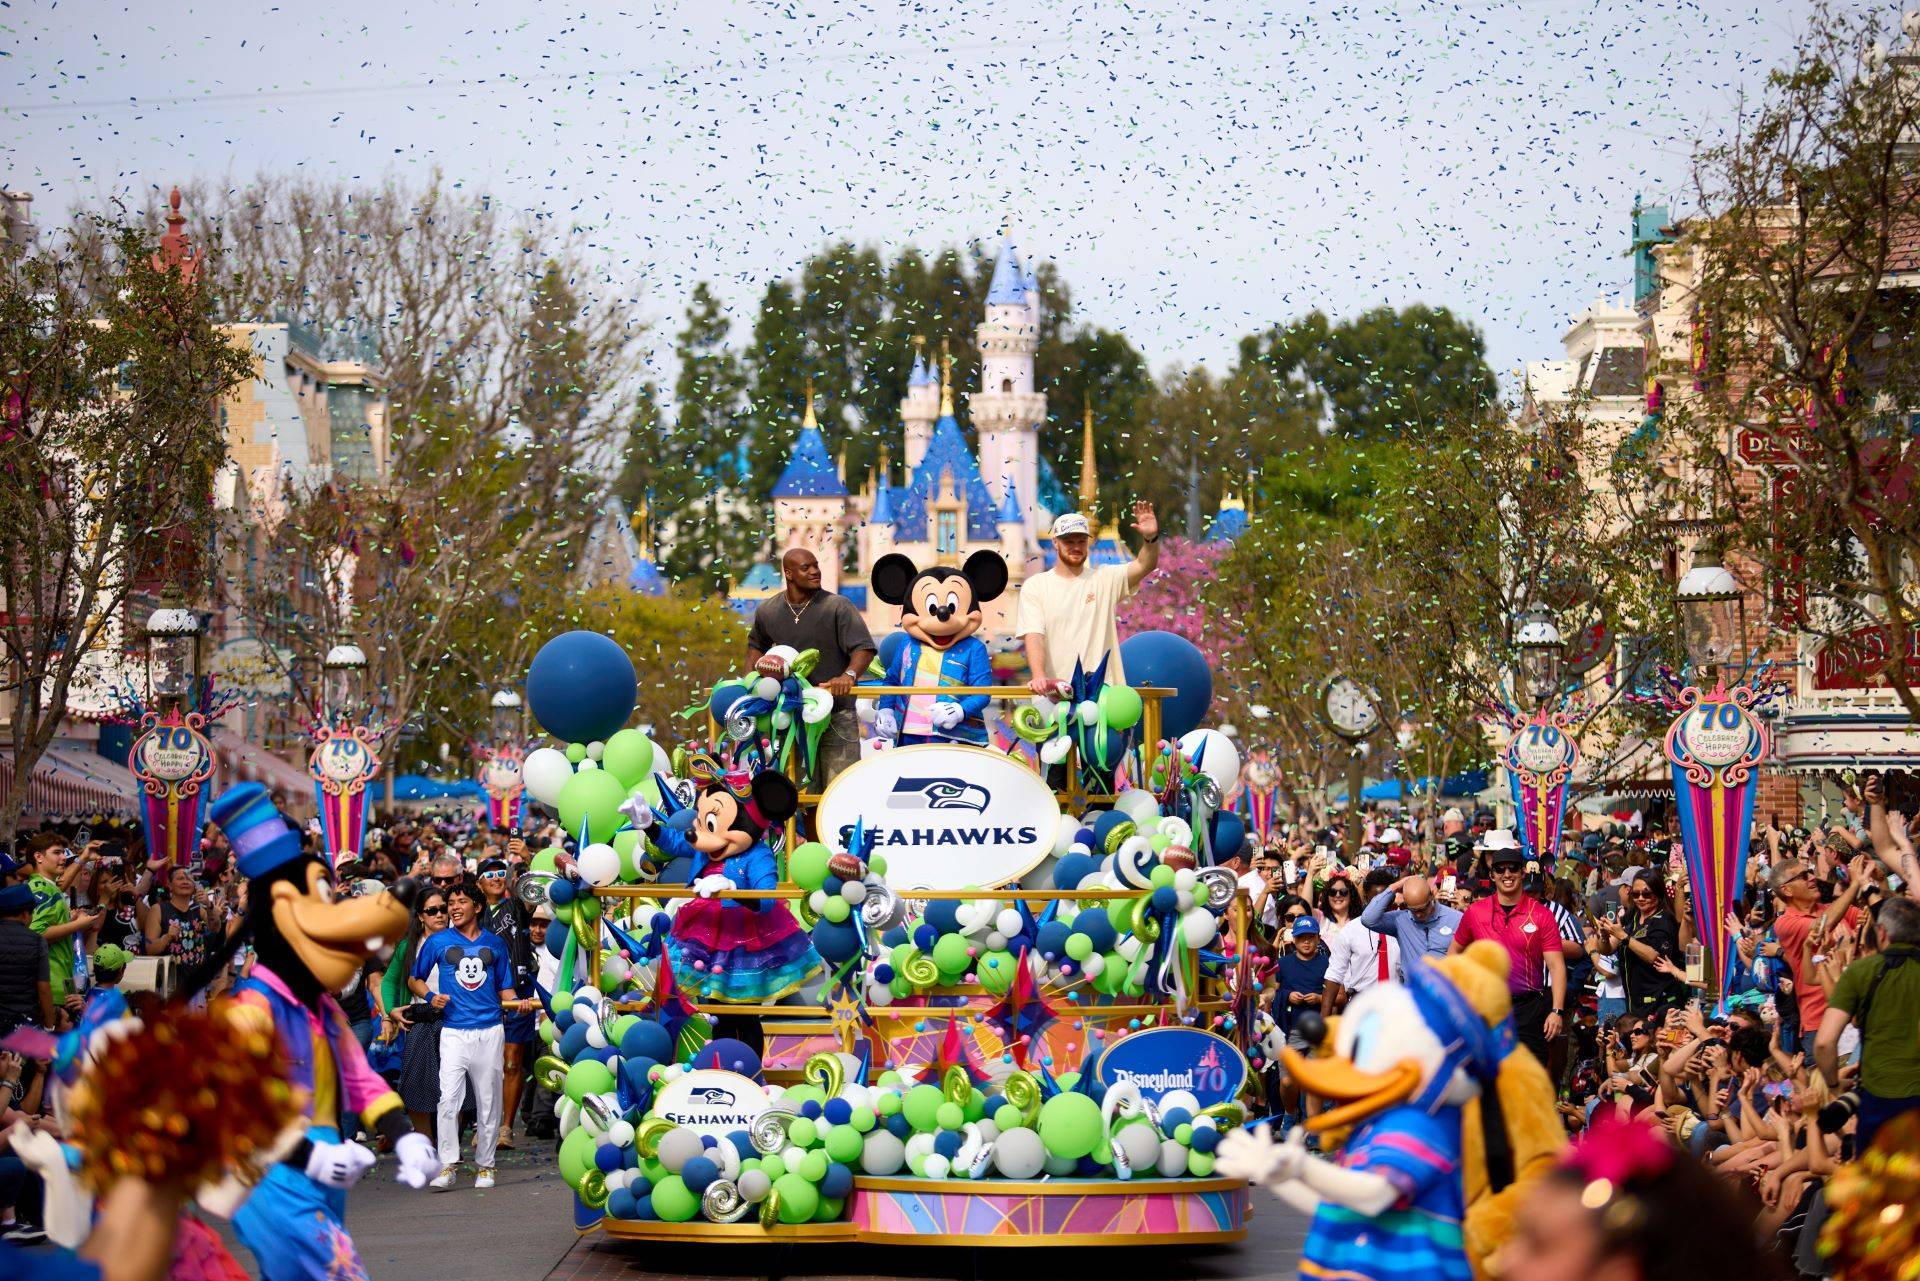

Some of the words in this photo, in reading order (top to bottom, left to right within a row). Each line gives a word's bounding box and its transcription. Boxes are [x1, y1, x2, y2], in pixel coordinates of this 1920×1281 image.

[1698, 703, 1742, 730] 70
[155, 726, 192, 750] 70
[330, 738, 358, 756] 70
[1528, 724, 1560, 748] 70
[837, 1008, 854, 1021] 70
[1113, 1068, 1195, 1093] Disneyland
[1193, 1065, 1228, 1092] 70
